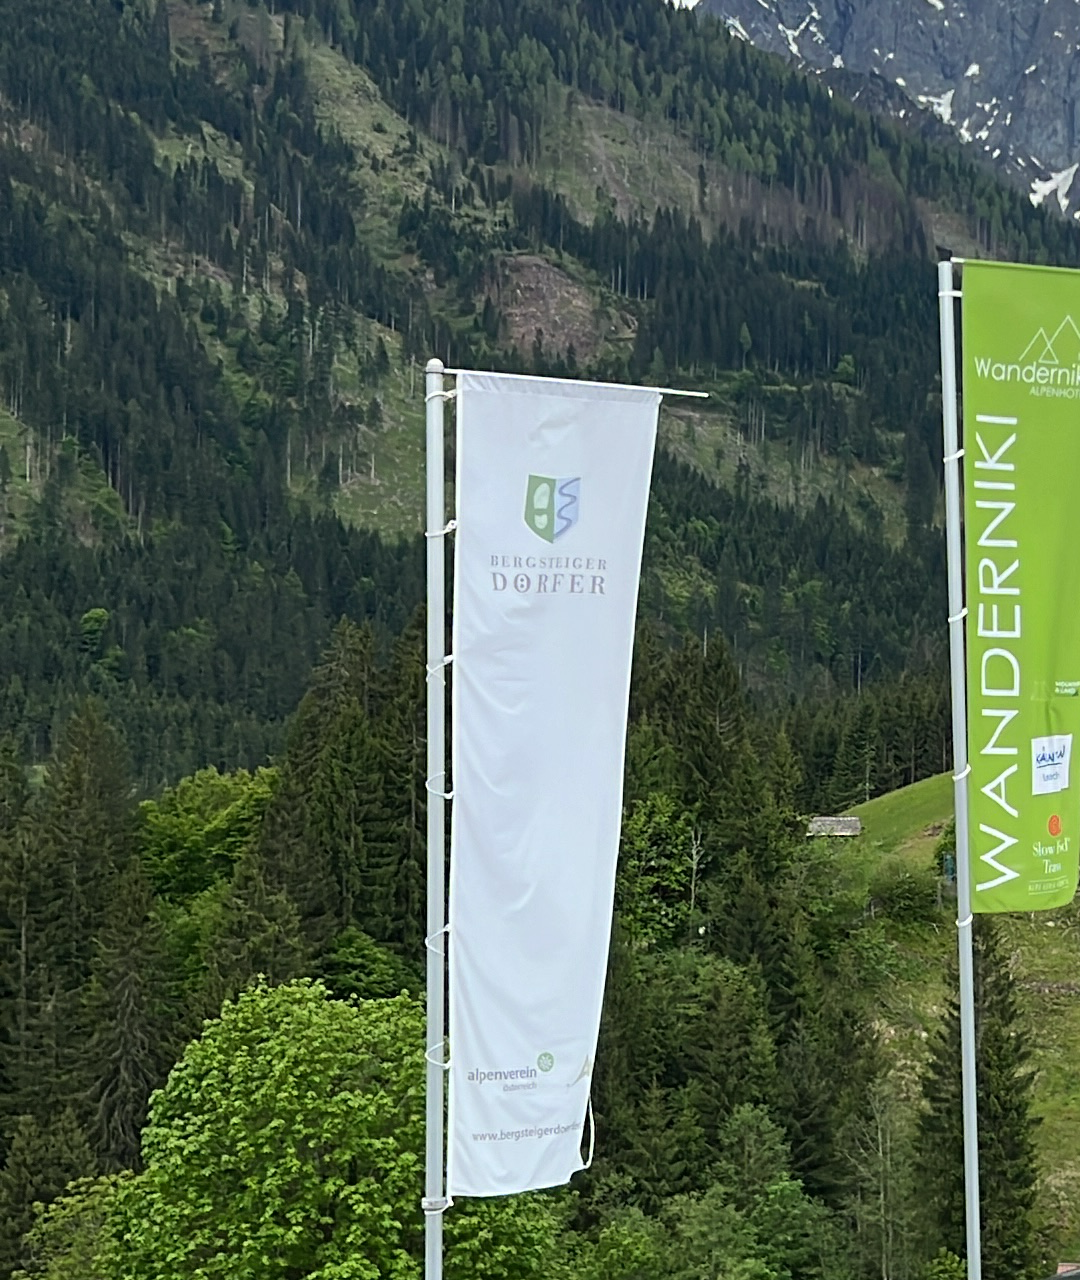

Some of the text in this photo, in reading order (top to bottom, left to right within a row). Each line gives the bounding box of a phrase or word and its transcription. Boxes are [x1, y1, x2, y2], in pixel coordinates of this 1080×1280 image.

[490, 554, 607, 570] BERGSTEIGER
[491, 571, 606, 595] DÖRFER
[974, 414, 1021, 892] WANDERNIKI
[1032, 841, 1056, 857] Slow
[467, 1065, 537, 1085] alpenverein
